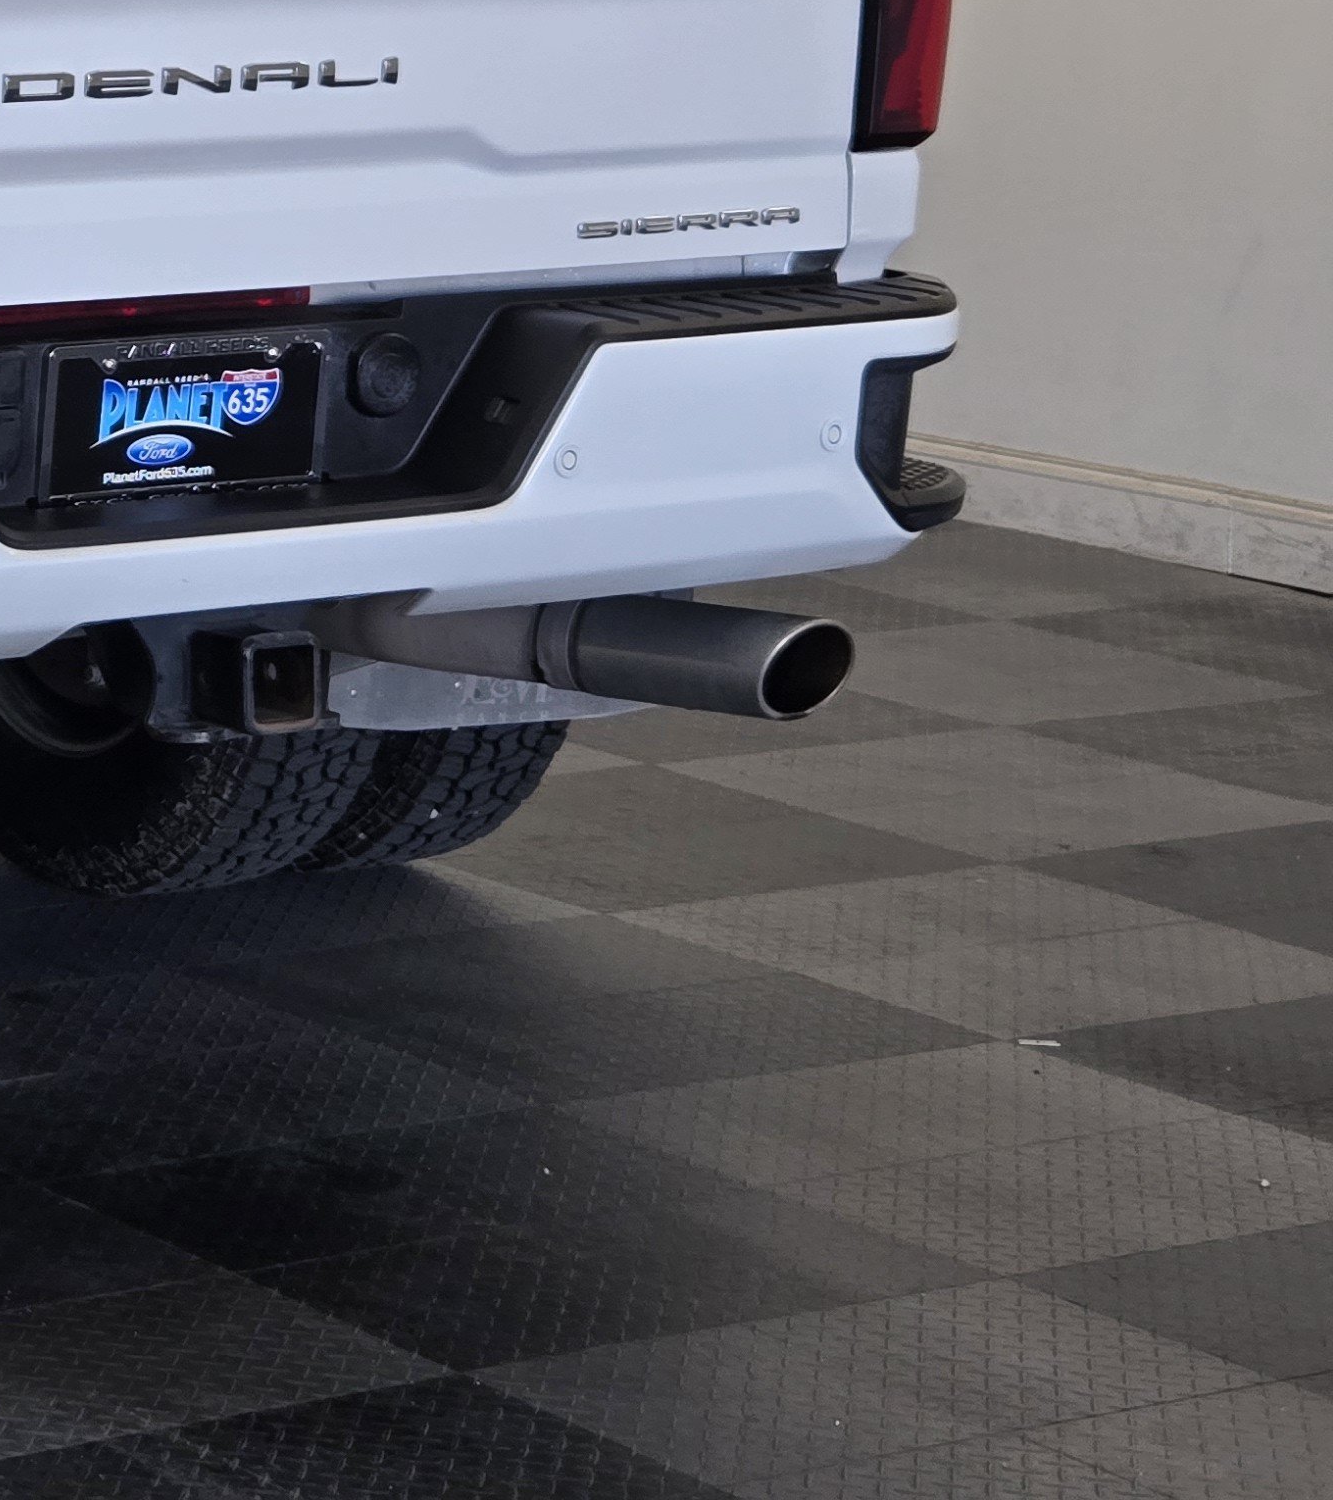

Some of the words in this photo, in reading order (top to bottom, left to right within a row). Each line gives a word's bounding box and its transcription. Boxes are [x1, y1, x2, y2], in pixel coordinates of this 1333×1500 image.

[1, 56, 399, 104] DENALI
[576, 205, 801, 240] SIERRA
[99, 379, 229, 443] PLANET
[228, 387, 270, 415] 635
[138, 437, 177, 461] Ford
[102, 465, 213, 484] PlanetFord635.com
